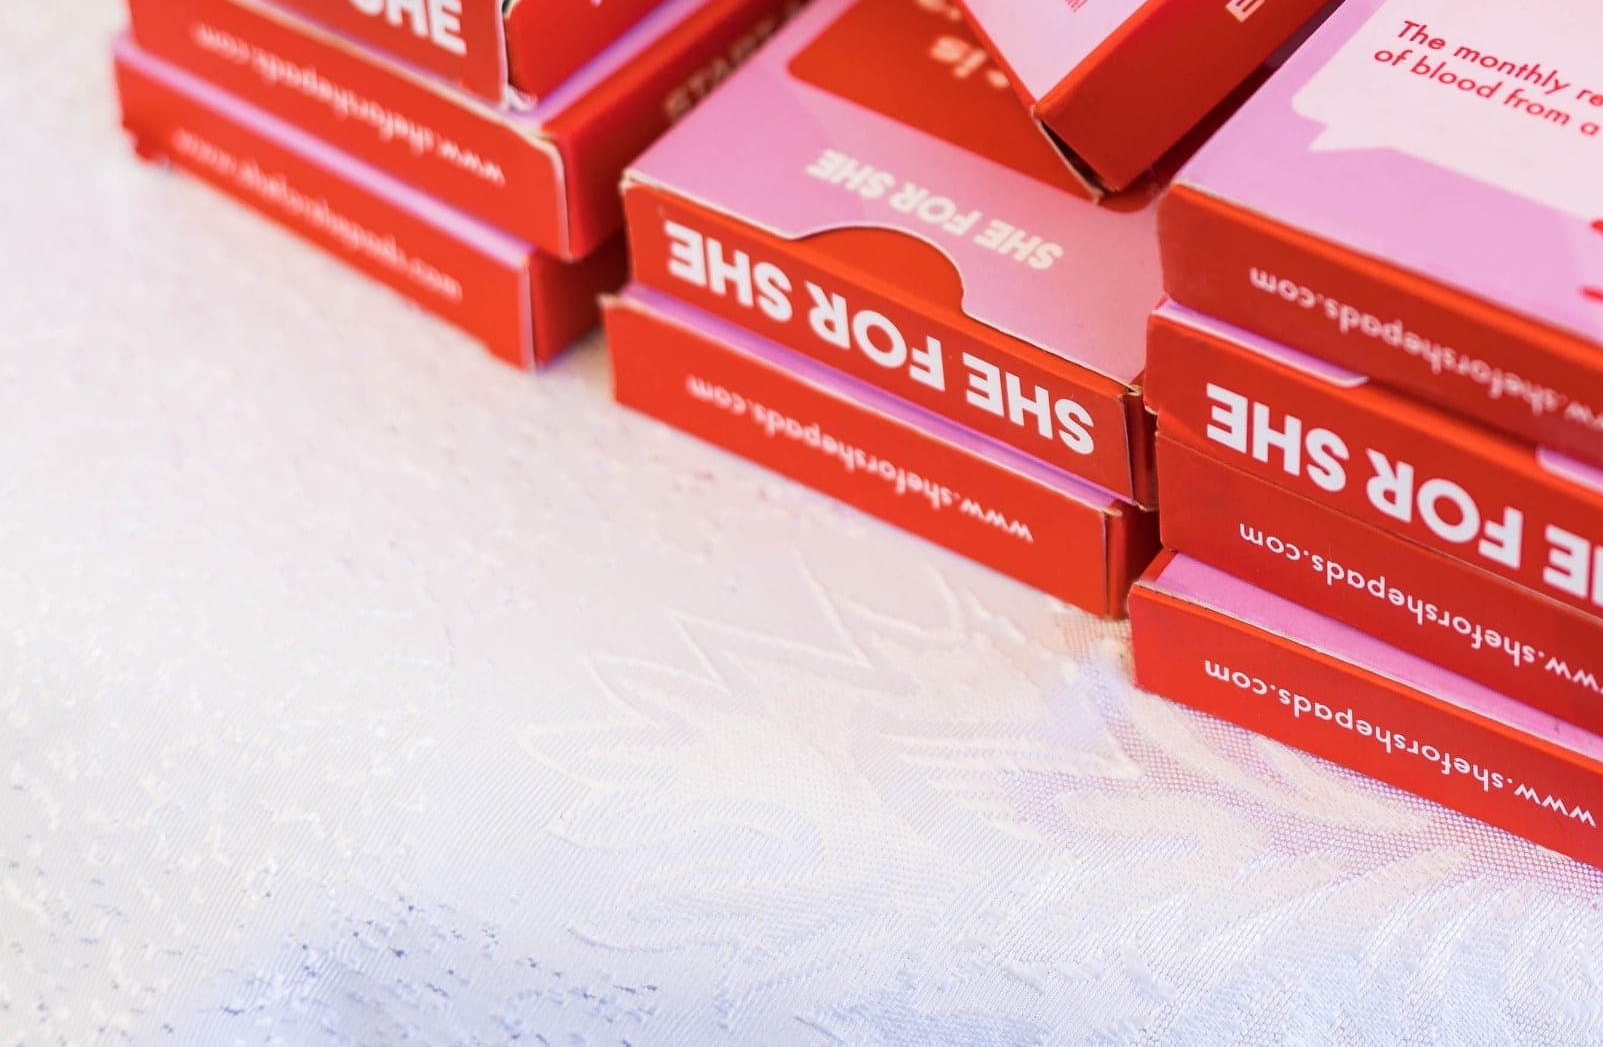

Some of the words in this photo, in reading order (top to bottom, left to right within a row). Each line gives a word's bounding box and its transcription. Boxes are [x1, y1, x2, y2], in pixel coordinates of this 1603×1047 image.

[1374, 49, 1413, 66] of
[1410, 55, 1503, 99] blood
[1504, 88, 1570, 126] from
[1579, 121, 1600, 137] a
[1398, 20, 1446, 50] The
[1453, 46, 1570, 95] monthly
[805, 148, 895, 200] SHE
[888, 181, 982, 237] FOR
[664, 220, 793, 323] SHE
[973, 218, 1063, 271] SHE
[804, 280, 946, 391] FOR
[962, 352, 1095, 455] SHE
[1206, 382, 1350, 492] SHE
[687, 375, 1034, 543] www.sheforshepads.com
[1365, 448, 1523, 570] FOR
[1204, 659, 1597, 828] www.sheforshepads.com
